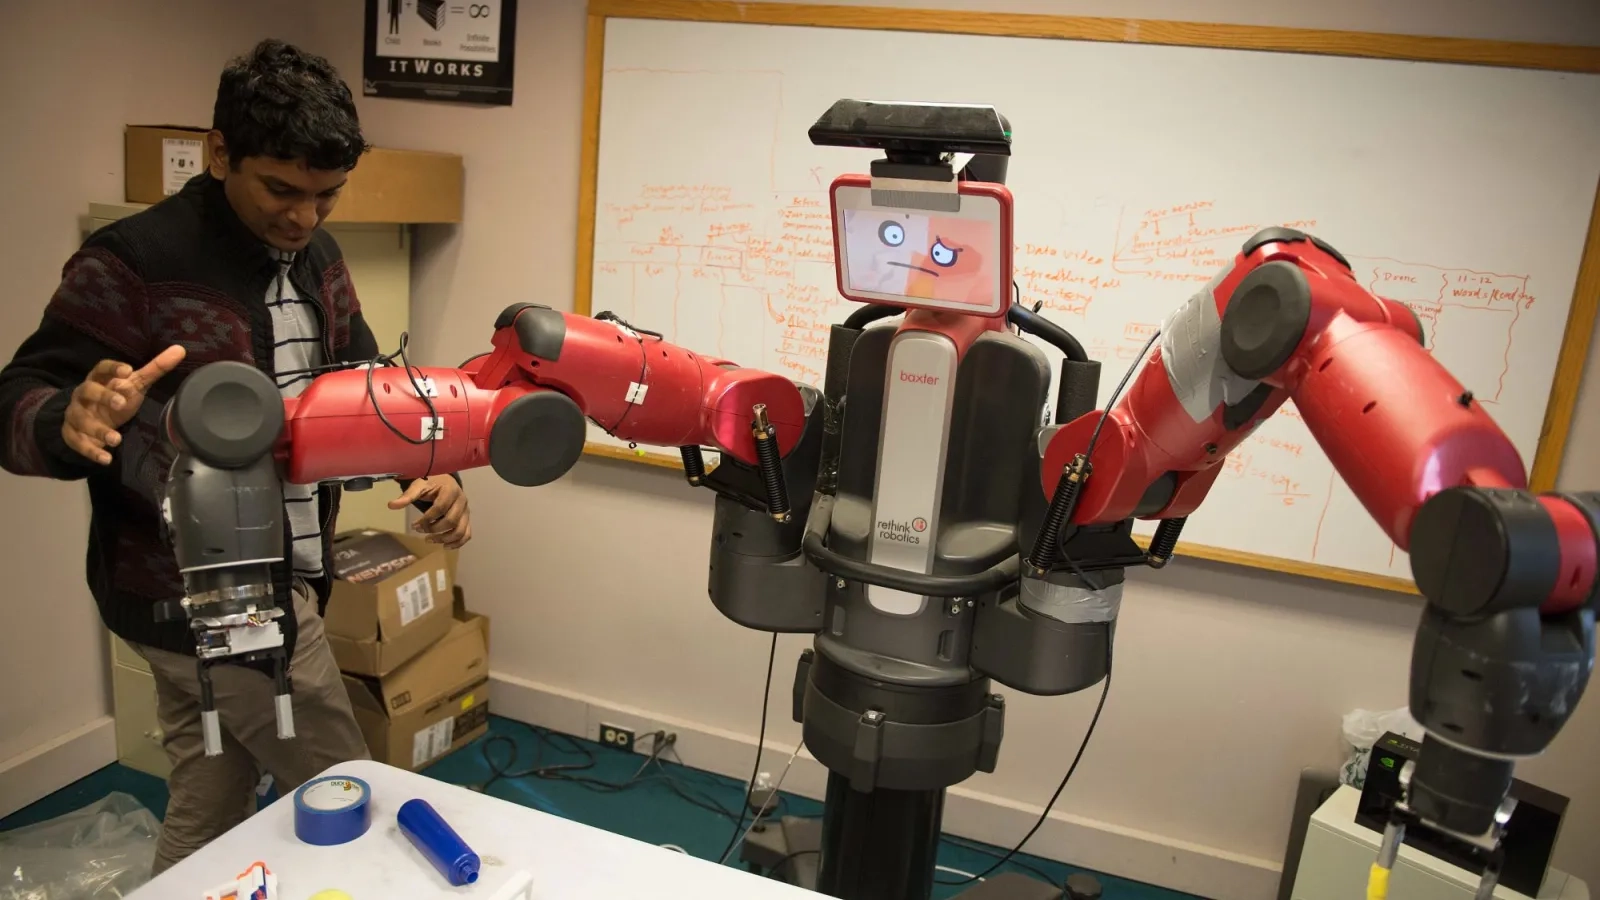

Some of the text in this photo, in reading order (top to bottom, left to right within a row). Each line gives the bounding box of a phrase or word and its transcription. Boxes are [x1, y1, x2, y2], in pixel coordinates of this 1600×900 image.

[389, 59, 484, 77] IT WORKS
[900, 370, 940, 386] baxter
[877, 519, 911, 534] rethink
[879, 529, 920, 545] robotics
